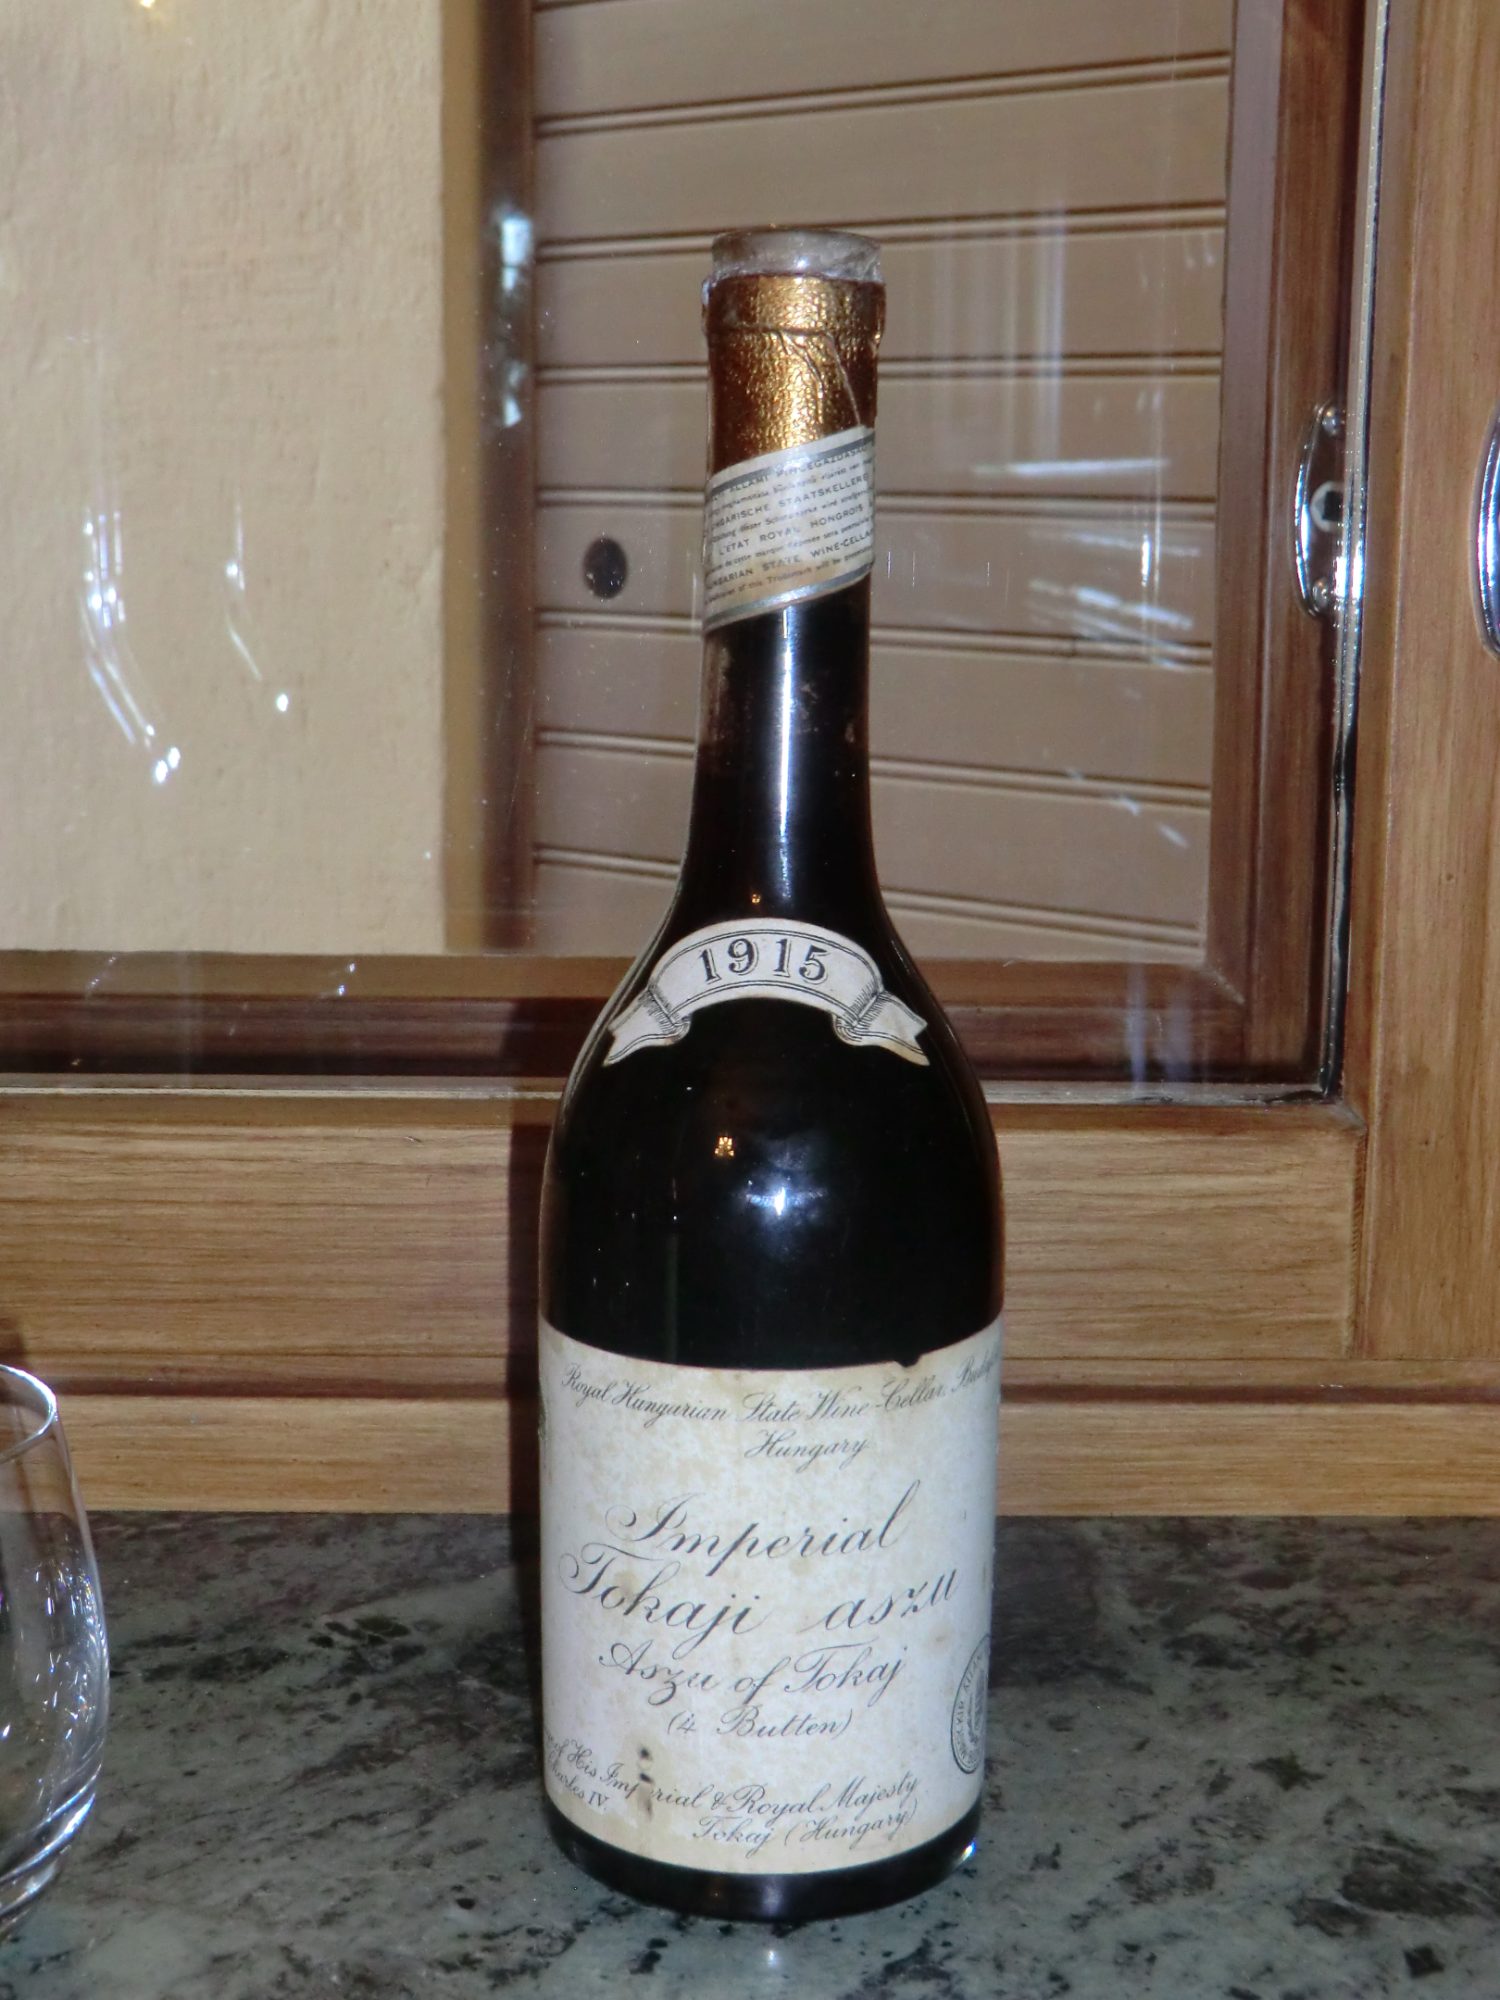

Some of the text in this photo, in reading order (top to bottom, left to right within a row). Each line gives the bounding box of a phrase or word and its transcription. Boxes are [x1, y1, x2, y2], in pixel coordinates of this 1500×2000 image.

[760, 526, 801, 542] ROYAL
[810, 504, 863, 528] HONGROIS
[698, 937, 831, 985] 1915
[562, 1362, 618, 1408] Royal
[611, 1379, 728, 1429] Hungarian
[737, 1391, 801, 1422] State
[744, 1430, 868, 1473] Hungary
[605, 1479, 921, 1577] Imperial
[558, 1541, 769, 1661] Tokaji
[598, 1637, 908, 1707] Aszu of Tokaj
[667, 1705, 853, 1740] (4 Butten)
[567, 1739, 597, 1777] His
[711, 1790, 730, 1811] &
[727, 1783, 832, 1827] Royal
[820, 1771, 919, 1822] Majesty
[692, 1799, 918, 1858] Tokaj (Hungary)
